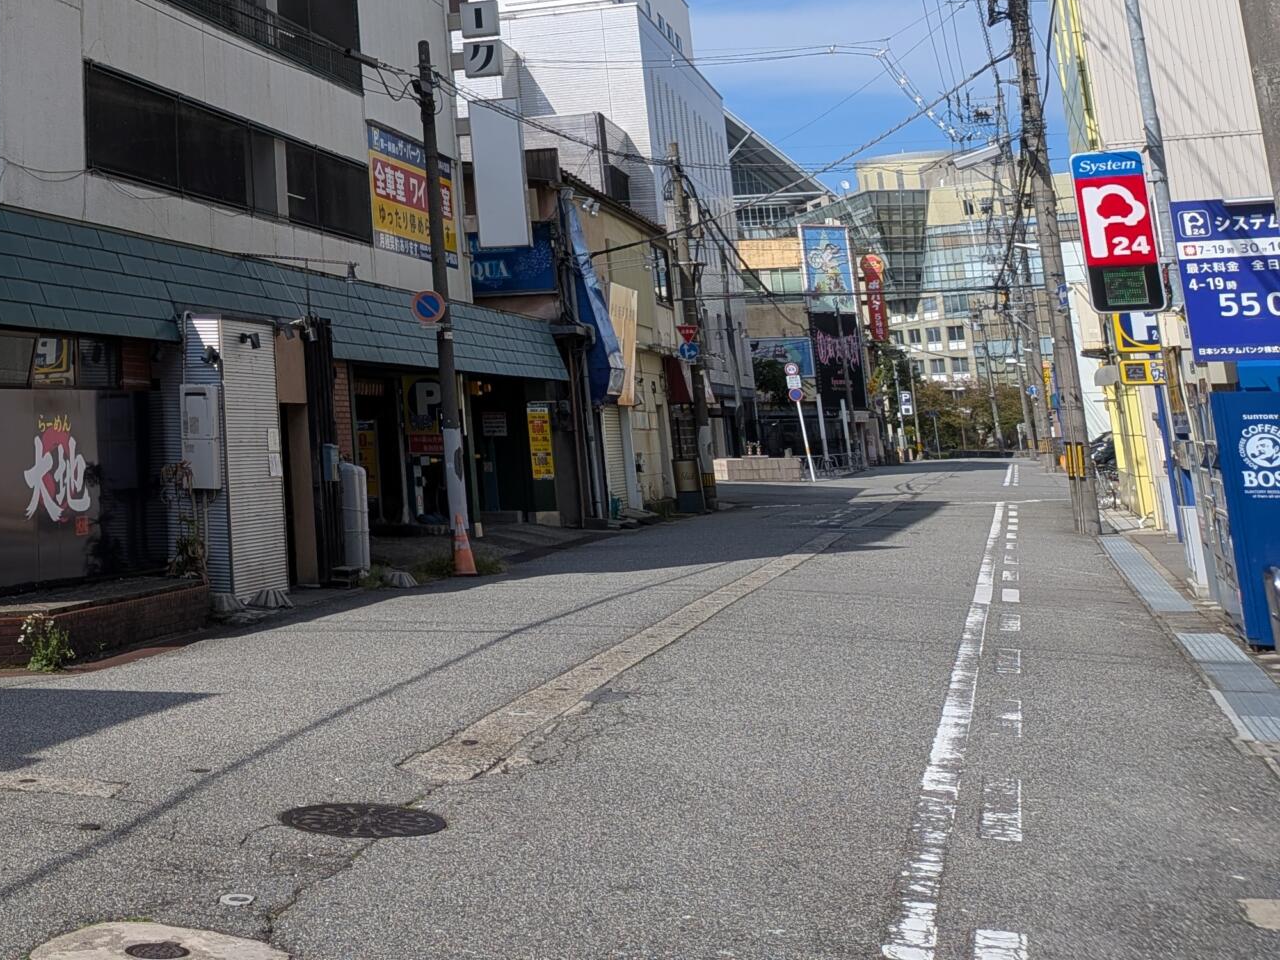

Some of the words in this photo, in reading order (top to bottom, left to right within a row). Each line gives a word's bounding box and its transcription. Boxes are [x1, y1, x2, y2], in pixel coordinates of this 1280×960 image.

[1078, 158, 1137, 175] System
[1192, 228, 1206, 236] 24
[1111, 235, 1151, 256] 24
[1186, 261, 1240, 274] 最大料金
[1188, 277, 1238, 291] 4-19時
[38, 414, 72, 432] らーめん
[23, 435, 91, 522] 大地
